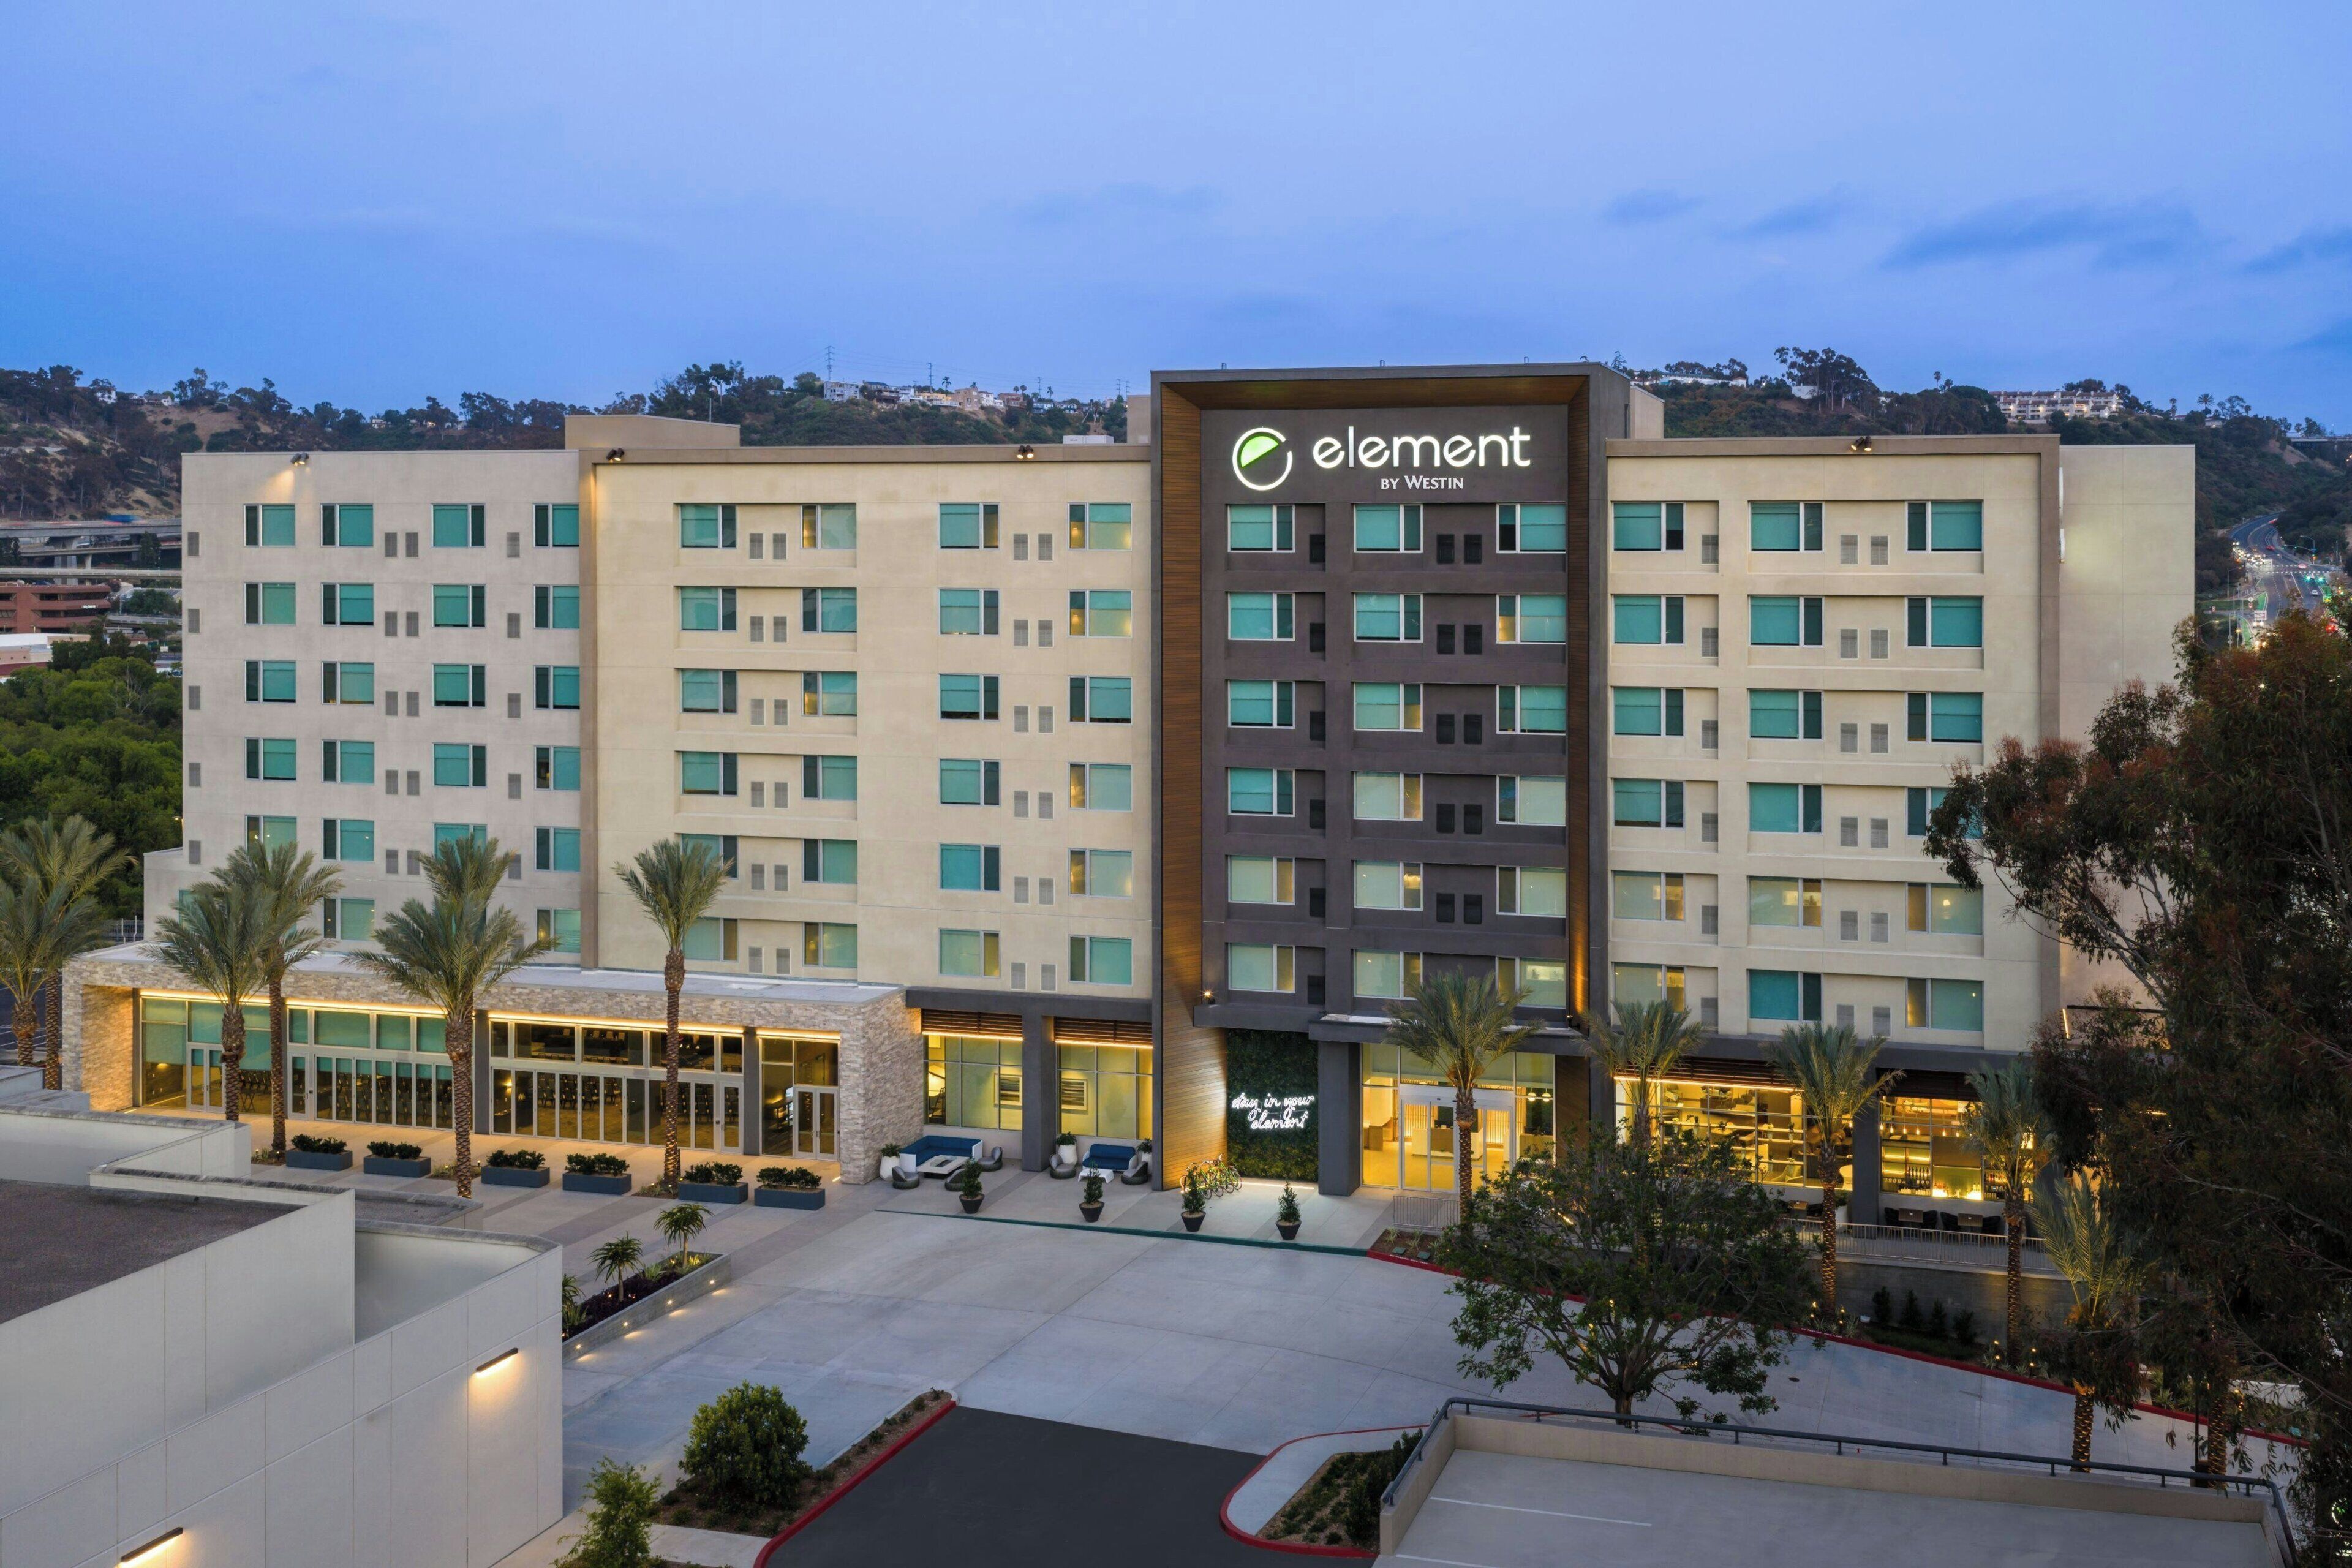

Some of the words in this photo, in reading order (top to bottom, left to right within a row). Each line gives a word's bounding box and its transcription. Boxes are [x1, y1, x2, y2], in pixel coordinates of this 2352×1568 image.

[1313, 426, 1531, 469] element
[1381, 478, 1400, 489] BY
[1404, 475, 1464, 489] WESTIN
[1231, 1092, 1261, 1121] stay
[1264, 1093, 1281, 1107] in
[1283, 1095, 1314, 1120] your
[1251, 1110, 1309, 1129] element
